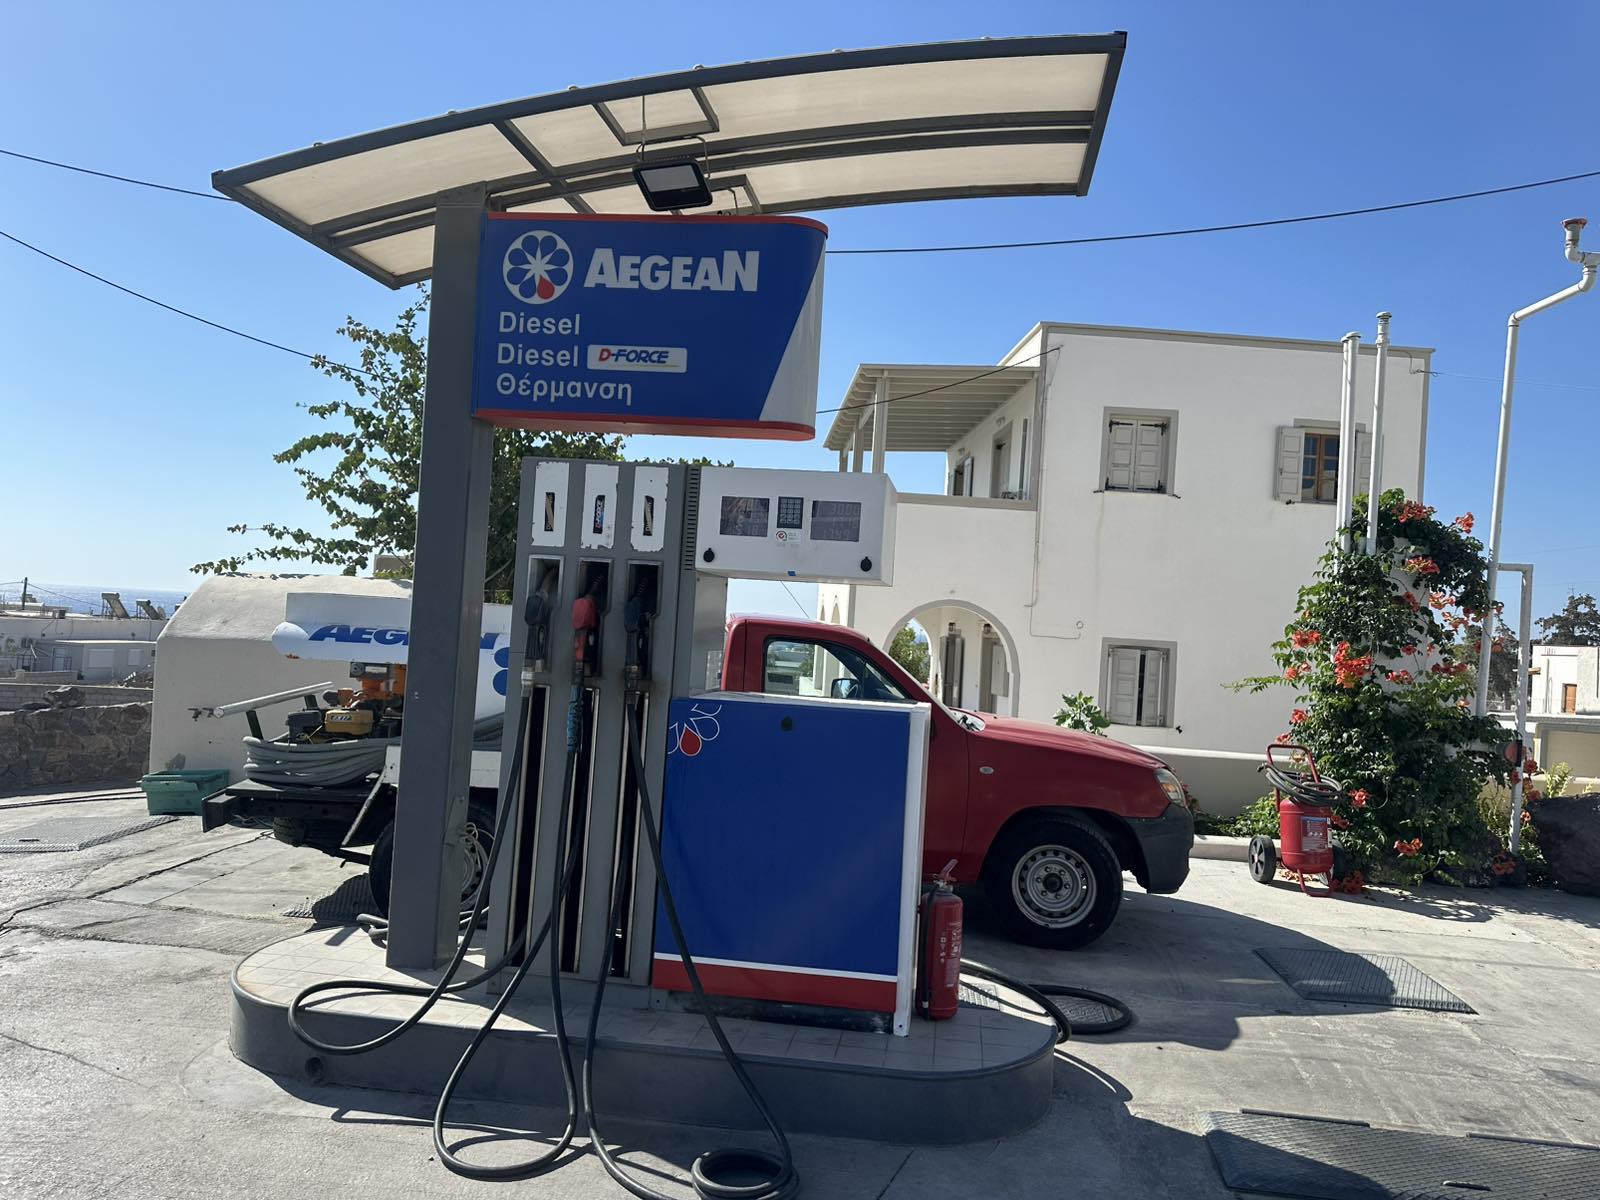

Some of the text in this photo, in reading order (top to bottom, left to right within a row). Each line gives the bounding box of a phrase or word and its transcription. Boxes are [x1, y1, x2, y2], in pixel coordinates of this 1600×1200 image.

[584, 248, 760, 292] AEGEAN
[499, 311, 581, 336] Diesel
[497, 342, 670, 367] Diesel D-FORCE
[496, 373, 632, 406] Θέρμανση
